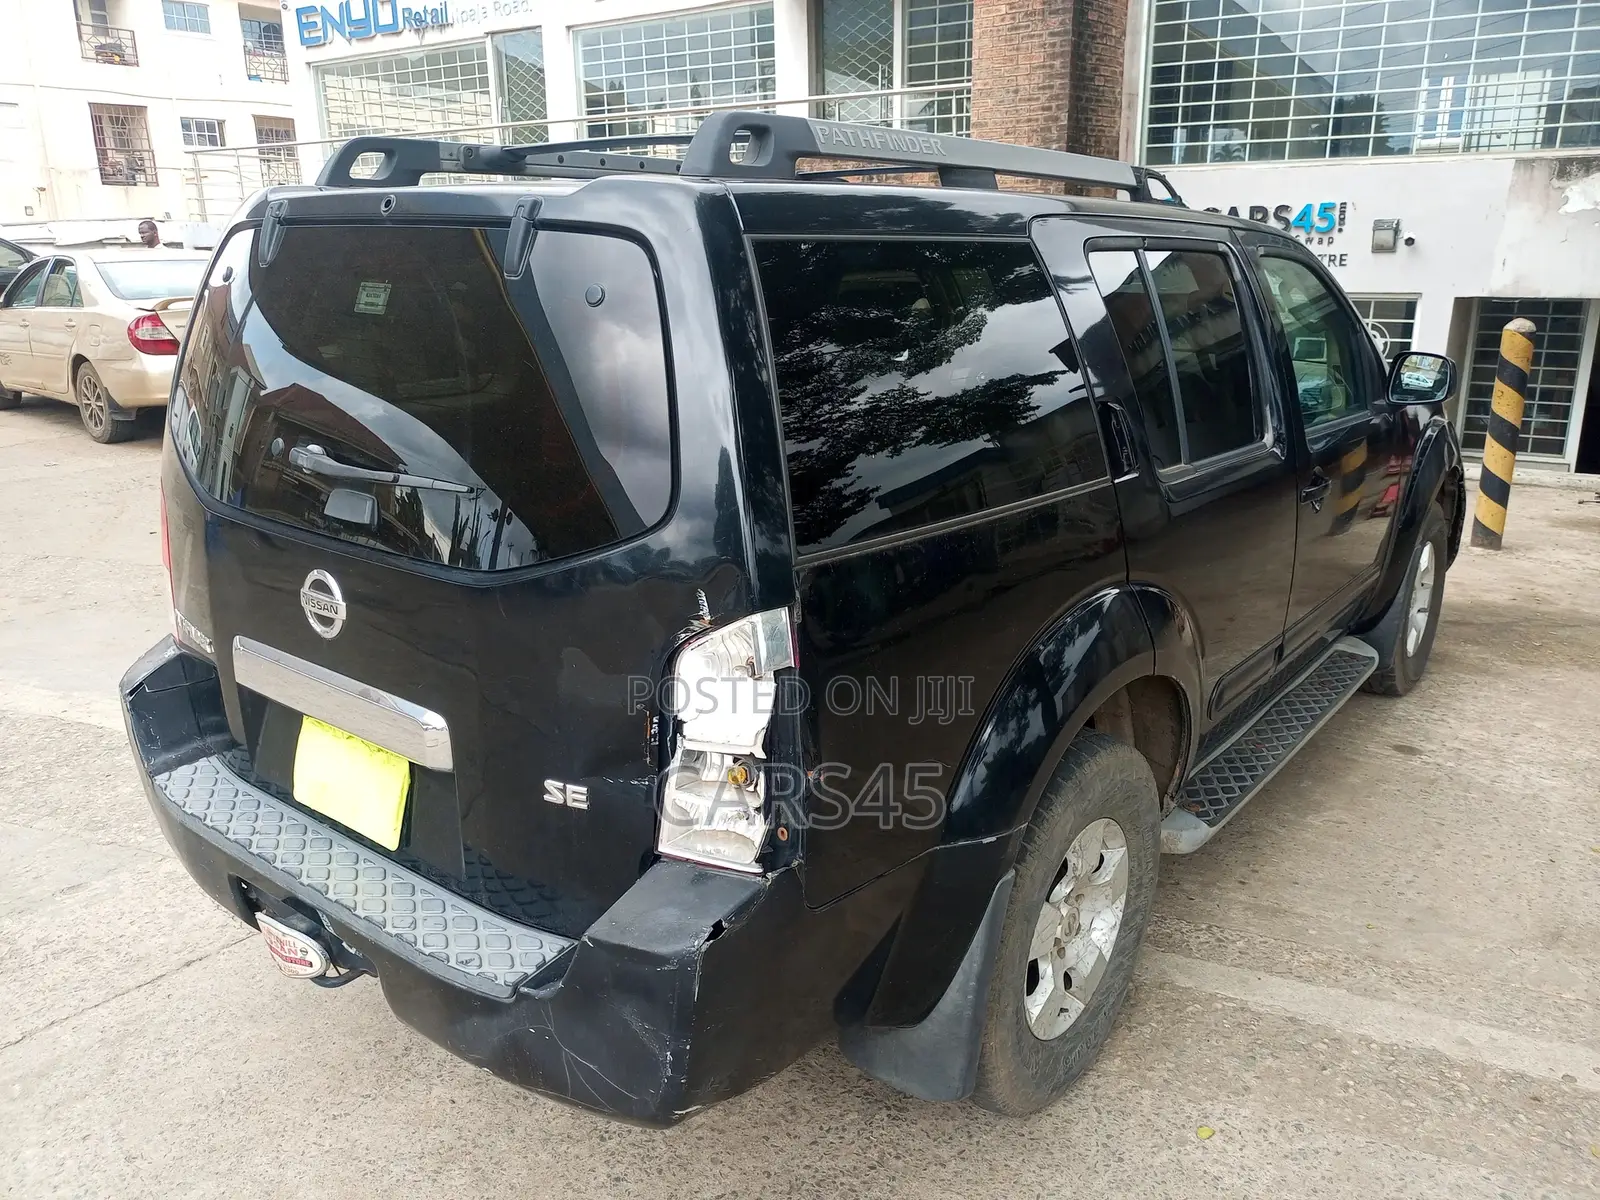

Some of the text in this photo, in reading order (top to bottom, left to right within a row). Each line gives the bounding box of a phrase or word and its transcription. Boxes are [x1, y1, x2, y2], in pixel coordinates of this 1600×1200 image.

[296, 0, 449, 46] ENYO Retail
[816, 126, 946, 156] PATHFINDER
[302, 596, 338, 615] NISSAN
[543, 779, 589, 810] SE
